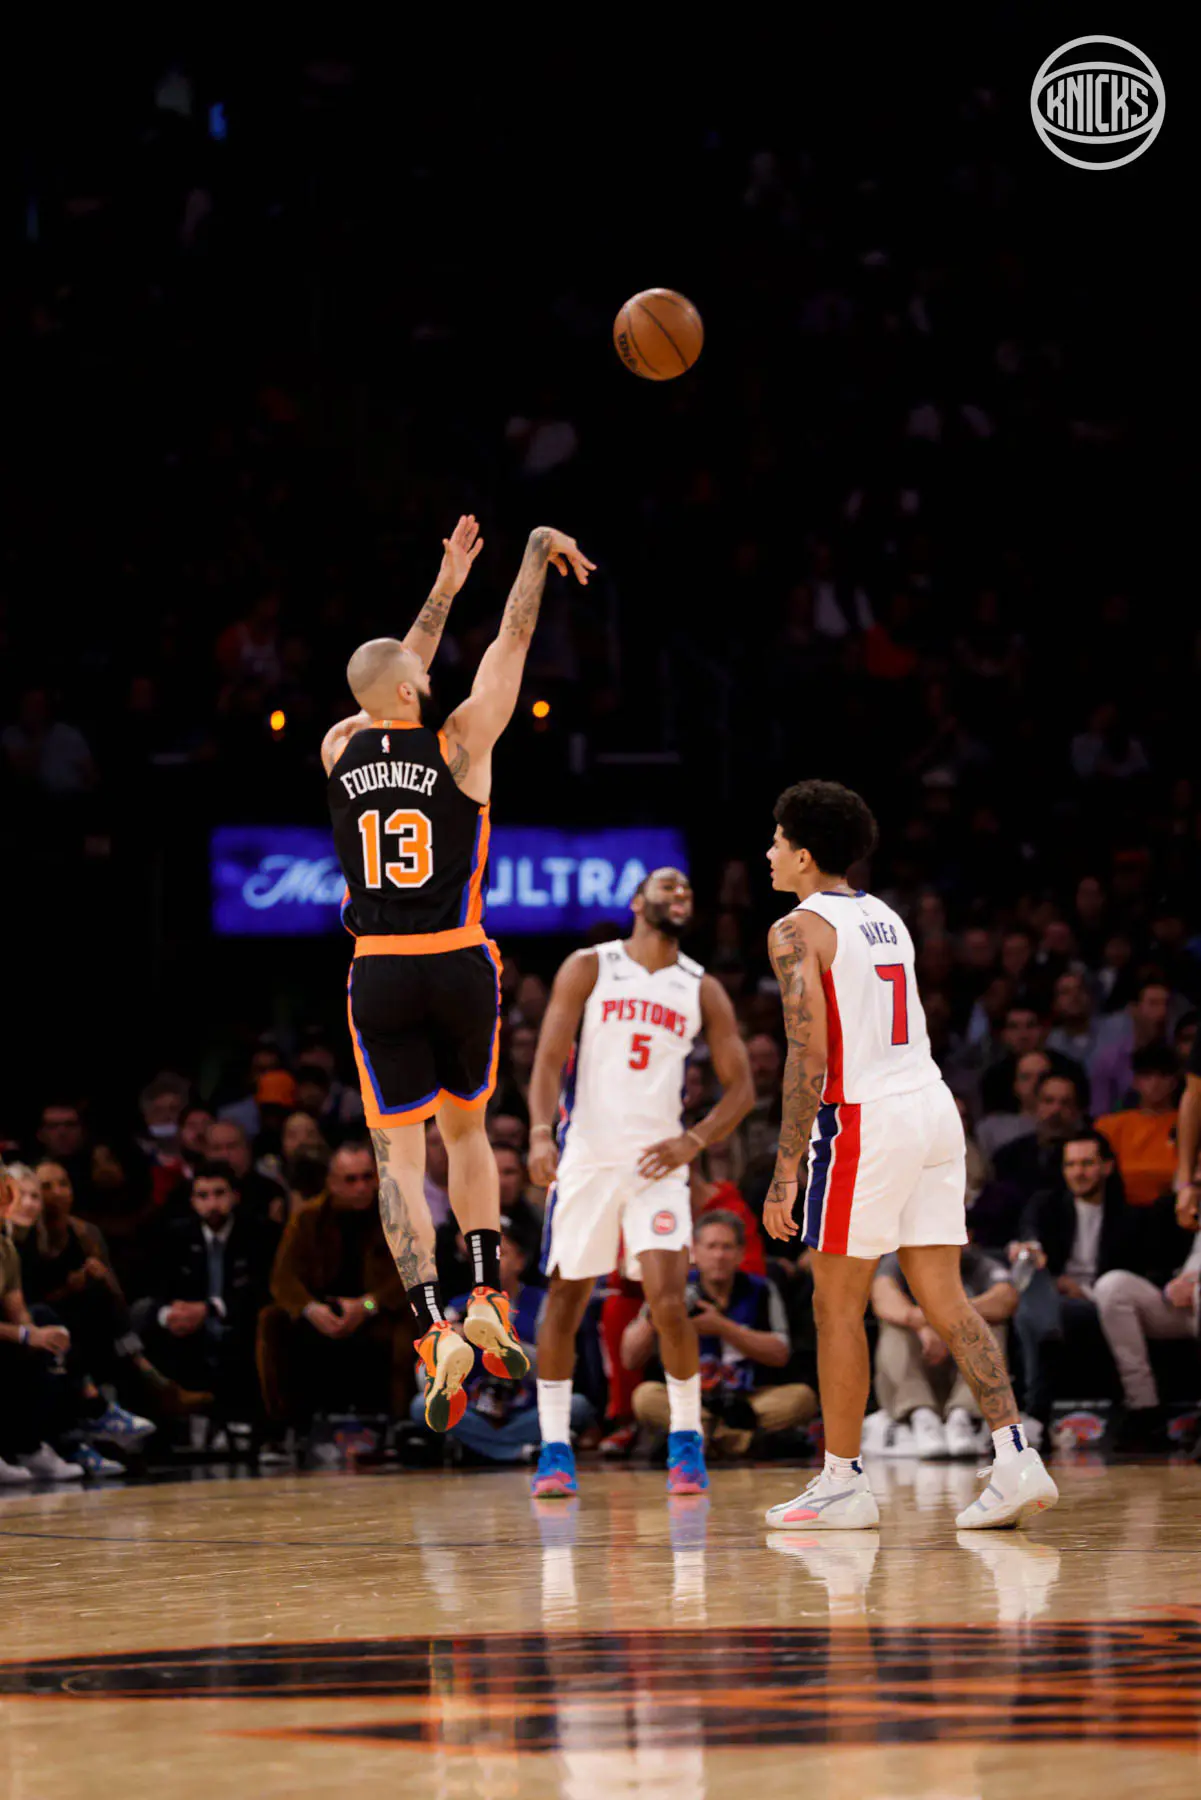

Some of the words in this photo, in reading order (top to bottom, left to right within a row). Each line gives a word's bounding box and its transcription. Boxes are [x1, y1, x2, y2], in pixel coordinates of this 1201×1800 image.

[340, 761, 438, 800] FOURNIER
[358, 808, 434, 889] 13
[602, 998, 687, 1038] PISTONS
[874, 963, 909, 1046] 7
[628, 1033, 652, 1071] 5
